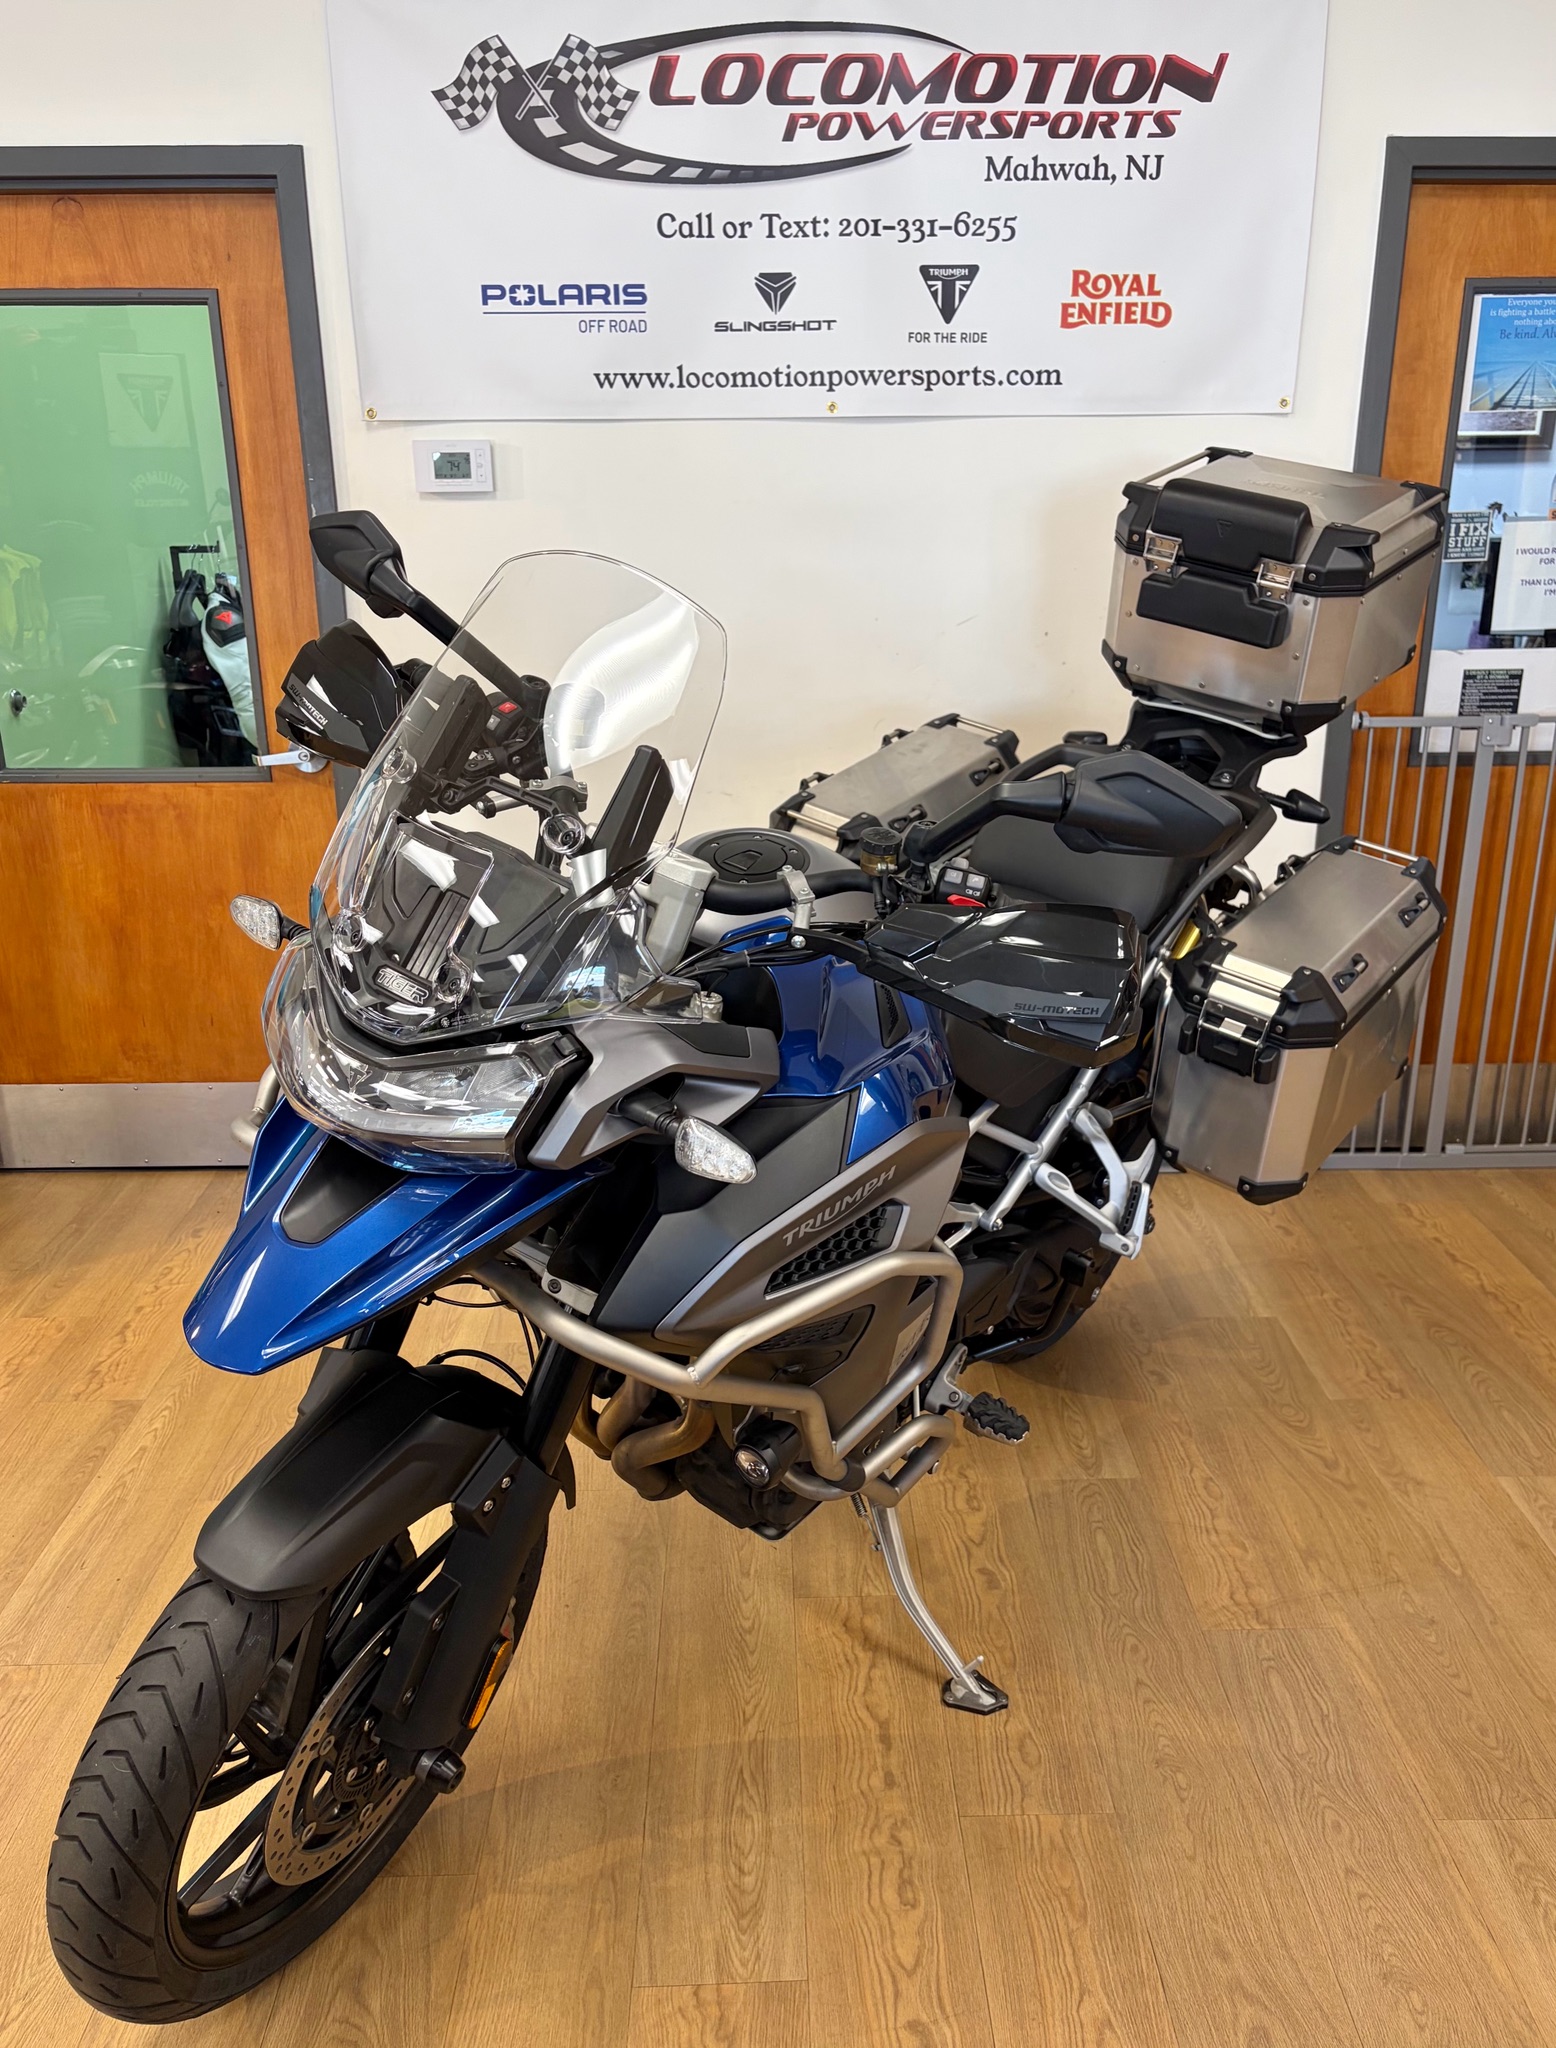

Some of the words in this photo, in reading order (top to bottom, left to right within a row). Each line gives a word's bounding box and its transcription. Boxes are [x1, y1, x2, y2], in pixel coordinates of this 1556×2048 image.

[649, 52, 1230, 106] LOCOMOTION
[781, 110, 1182, 142] POWERSPORTS
[984, 154, 1117, 185] Mahwah,
[1124, 154, 1164, 180] NJ
[656, 212, 715, 239] Call
[722, 221, 753, 240] or
[760, 213, 830, 239] Text:
[838, 211, 1018, 243] 201-331-6255
[928, 268, 969, 279] TRIUMPH
[1070, 269, 1162, 300] ROYAL
[481, 283, 648, 306] POLARIS
[1507, 298, 1543, 307] Everyone
[1060, 301, 1172, 329] ENFIELD
[1498, 308, 1527, 318] fighting
[1534, 308, 1556, 316] battle
[578, 319, 605, 334] OFF
[609, 319, 648, 333] ROAD
[714, 320, 838, 333] SLINGSHOT
[1514, 318, 1543, 327] nothing
[908, 332, 931, 344] FOR
[934, 332, 957, 344] THE
[960, 332, 988, 344] RIDE
[1500, 329, 1512, 339] Be
[1514, 327, 1540, 339] kind.
[593, 363, 1063, 392] www.locomotionpowersports.com
[1449, 523, 1457, 537] I
[1459, 522, 1488, 536] FIX
[1448, 536, 1487, 548] STUFF
[1520, 547, 1550, 555] WOULD
[1539, 557, 1555, 565] FOR
[377, 967, 430, 1005] TIGER
[1014, 1002, 1100, 1016] SW-MOTECH
[782, 1165, 896, 1247] TRIUMPH
